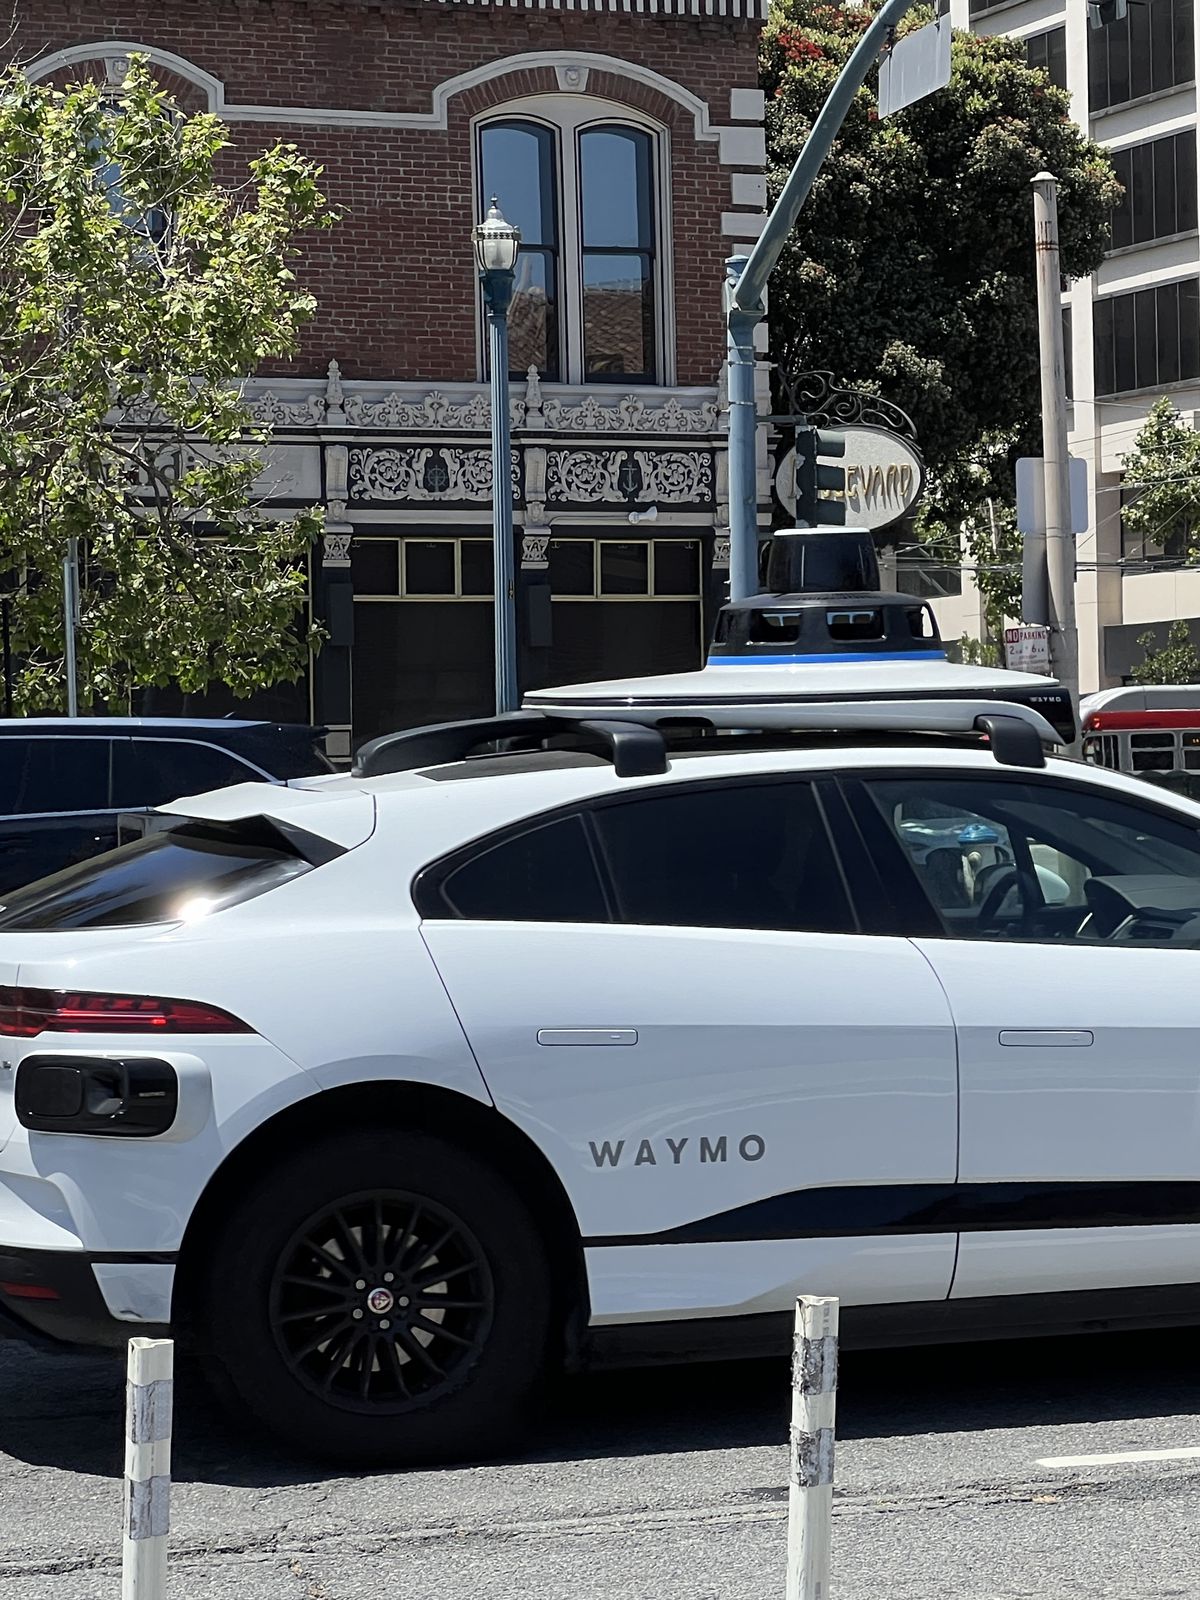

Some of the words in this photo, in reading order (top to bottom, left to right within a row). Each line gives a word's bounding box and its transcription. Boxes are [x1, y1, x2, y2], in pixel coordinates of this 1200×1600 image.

[1007, 629, 1019, 643] NO
[1020, 631, 1046, 641] PARKING
[588, 1134, 766, 1168] WAYMO
